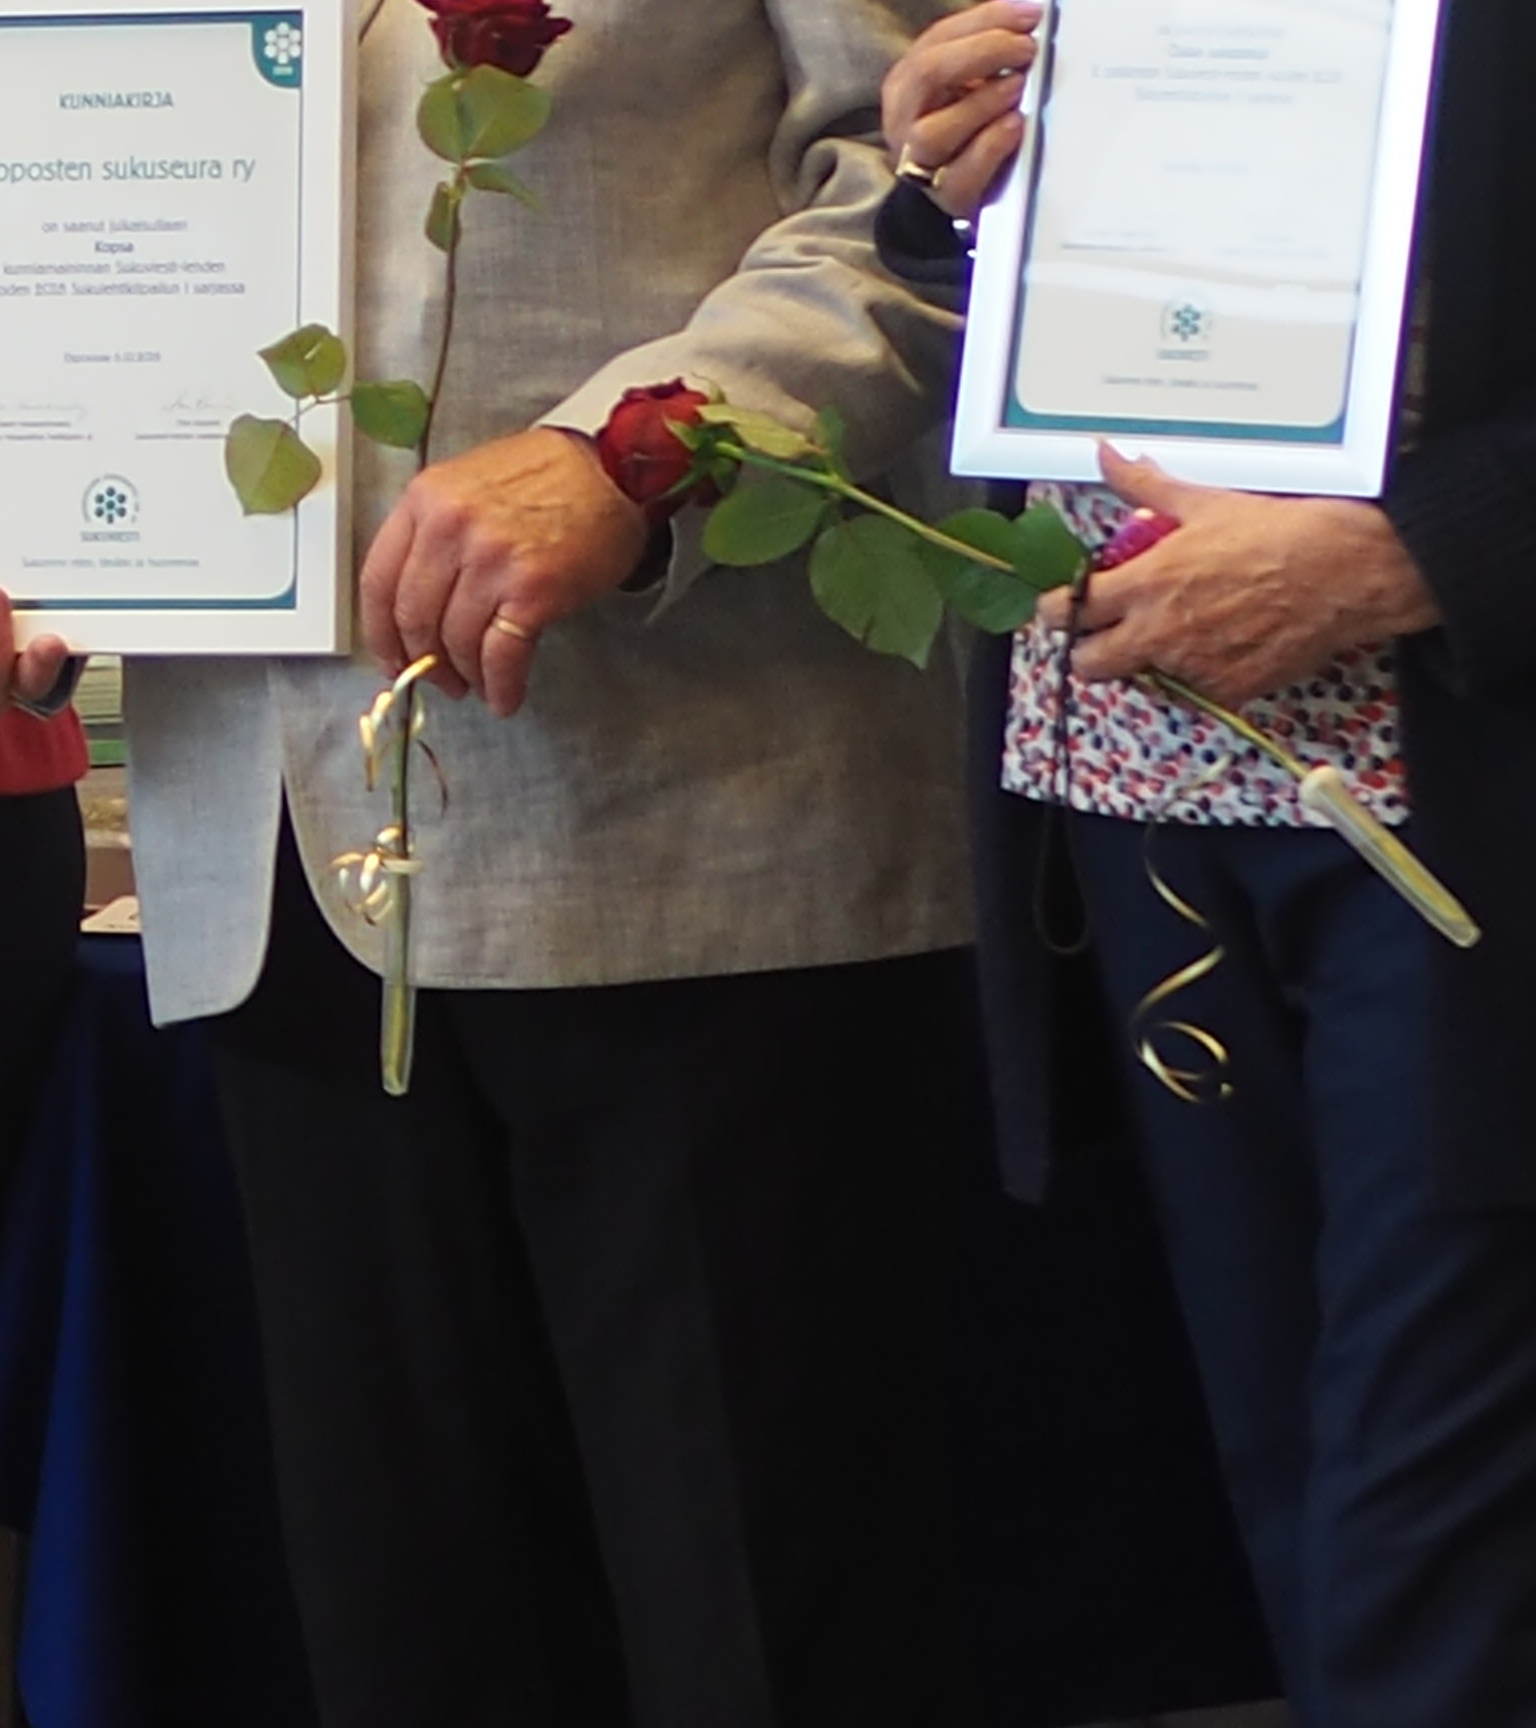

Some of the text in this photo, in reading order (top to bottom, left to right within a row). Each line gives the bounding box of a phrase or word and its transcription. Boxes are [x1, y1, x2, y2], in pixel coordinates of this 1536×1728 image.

[58, 91, 175, 110] KUNNIAKIRJA
[101, 155, 222, 180] sukuseura
[232, 157, 256, 182] ry
